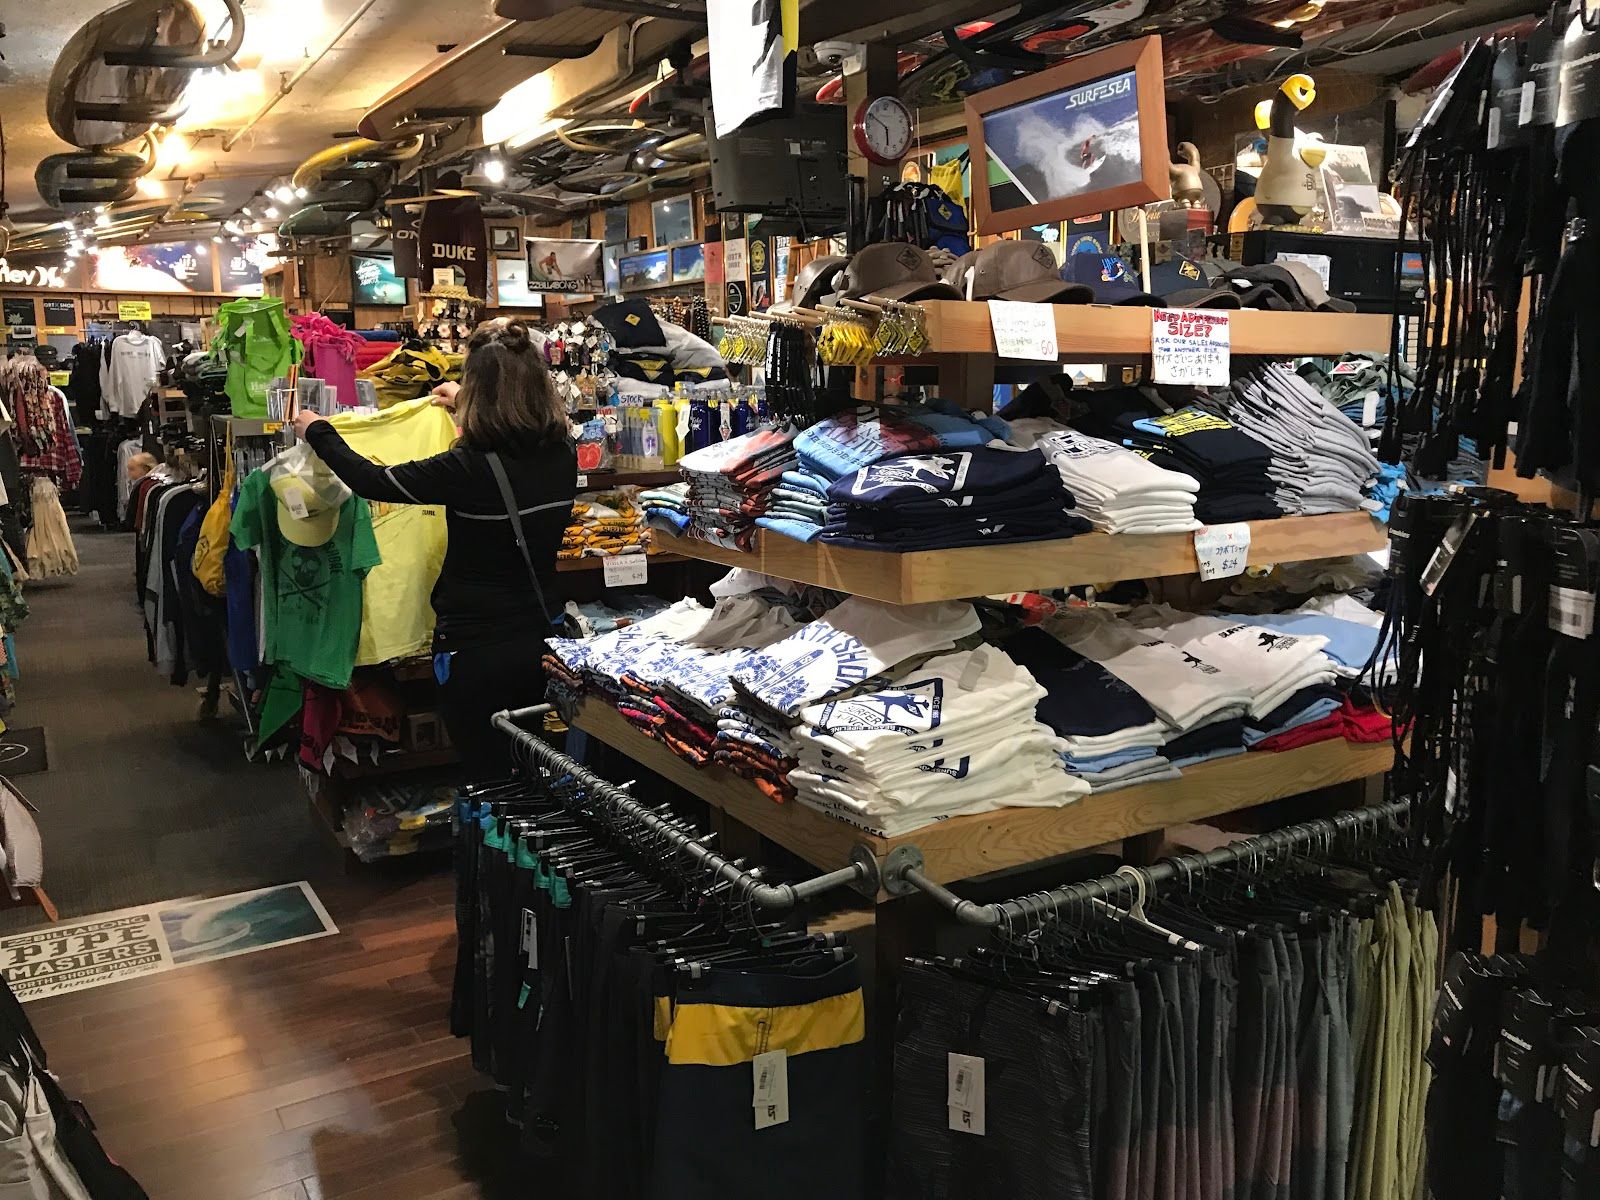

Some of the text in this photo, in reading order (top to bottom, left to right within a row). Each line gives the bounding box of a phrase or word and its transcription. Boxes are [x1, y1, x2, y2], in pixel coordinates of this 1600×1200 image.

[432, 243, 476, 261] DUKE
[538, 280, 577, 290] BILLABONG
[1167, 322, 1213, 338] SIZE?
[1188, 339, 1209, 347] SALES
[620, 394, 643, 404] STOCK
[1222, 557, 1238, 571] $24
[34, 915, 145, 942] BILLABONG
[5, 923, 150, 966] PIPE
[8, 942, 153, 981] MASTERS
[10, 977, 53, 991] NORTH
[58, 966, 104, 981] SHORE
[109, 955, 156, 970] HAWAII
[14, 971, 114, 999] 6th Annual
